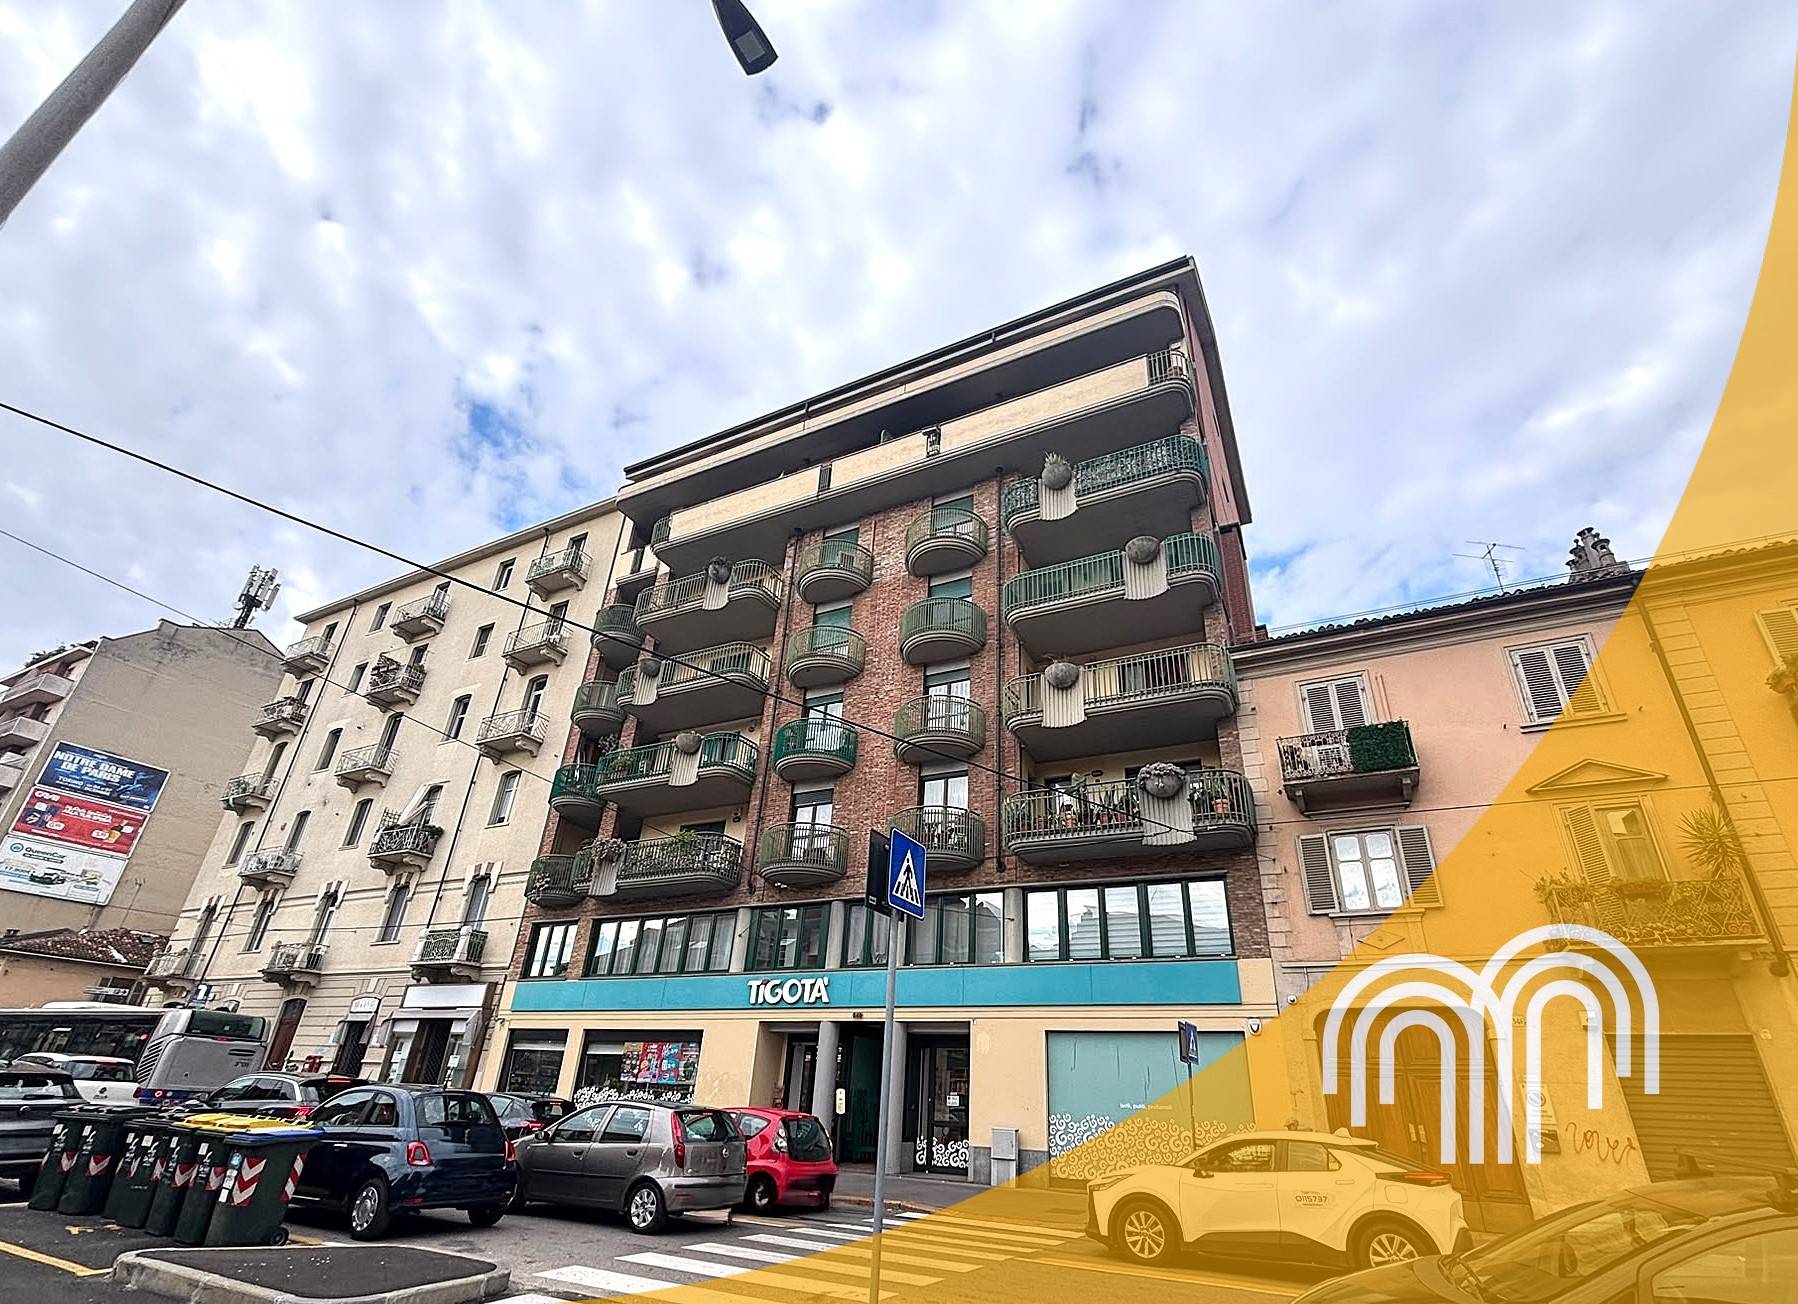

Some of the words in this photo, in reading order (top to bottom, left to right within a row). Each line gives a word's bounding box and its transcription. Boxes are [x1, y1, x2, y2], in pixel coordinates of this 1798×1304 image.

[53, 750, 97, 769] NOTRE
[99, 763, 136, 779] DAME
[81, 766, 121, 782] PARIS
